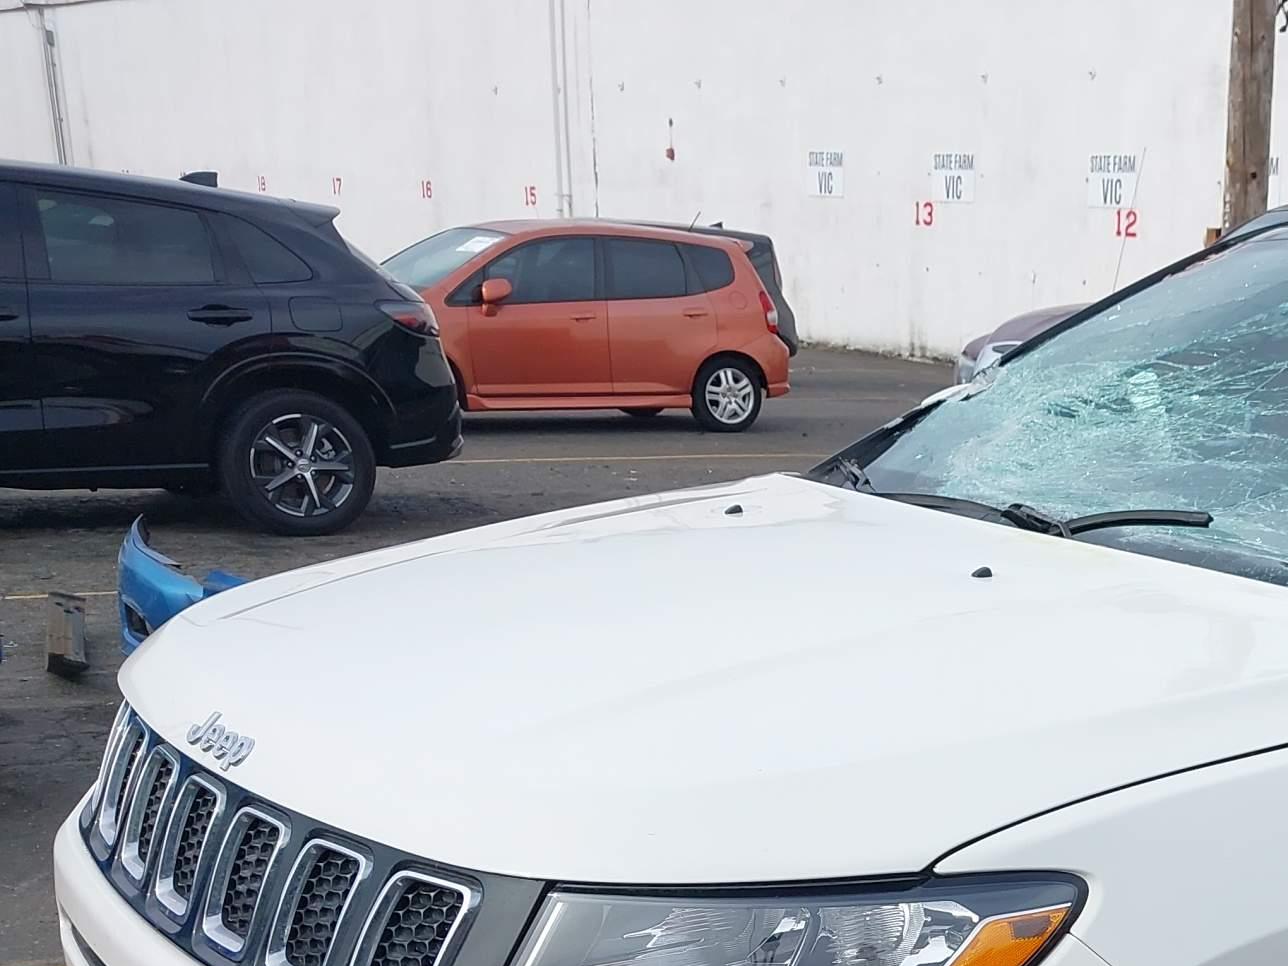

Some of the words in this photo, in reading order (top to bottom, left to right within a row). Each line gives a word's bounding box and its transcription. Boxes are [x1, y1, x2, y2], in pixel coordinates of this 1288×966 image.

[808, 152, 825, 167] STATE
[826, 152, 843, 167] FARM
[934, 154, 953, 170] STATE
[954, 154, 974, 170] FARM
[1090, 155, 1111, 173] STATE
[1113, 155, 1136, 173] FARM
[332, 177, 342, 195] 17
[421, 180, 432, 198] 16
[818, 171, 833, 194] VIC
[945, 175, 962, 200] VIC
[1102, 178, 1122, 205] VIC
[524, 186, 536, 206] 15
[915, 201, 934, 226] 13
[1116, 209, 1137, 237] 12
[186, 711, 256, 772] Jeep
